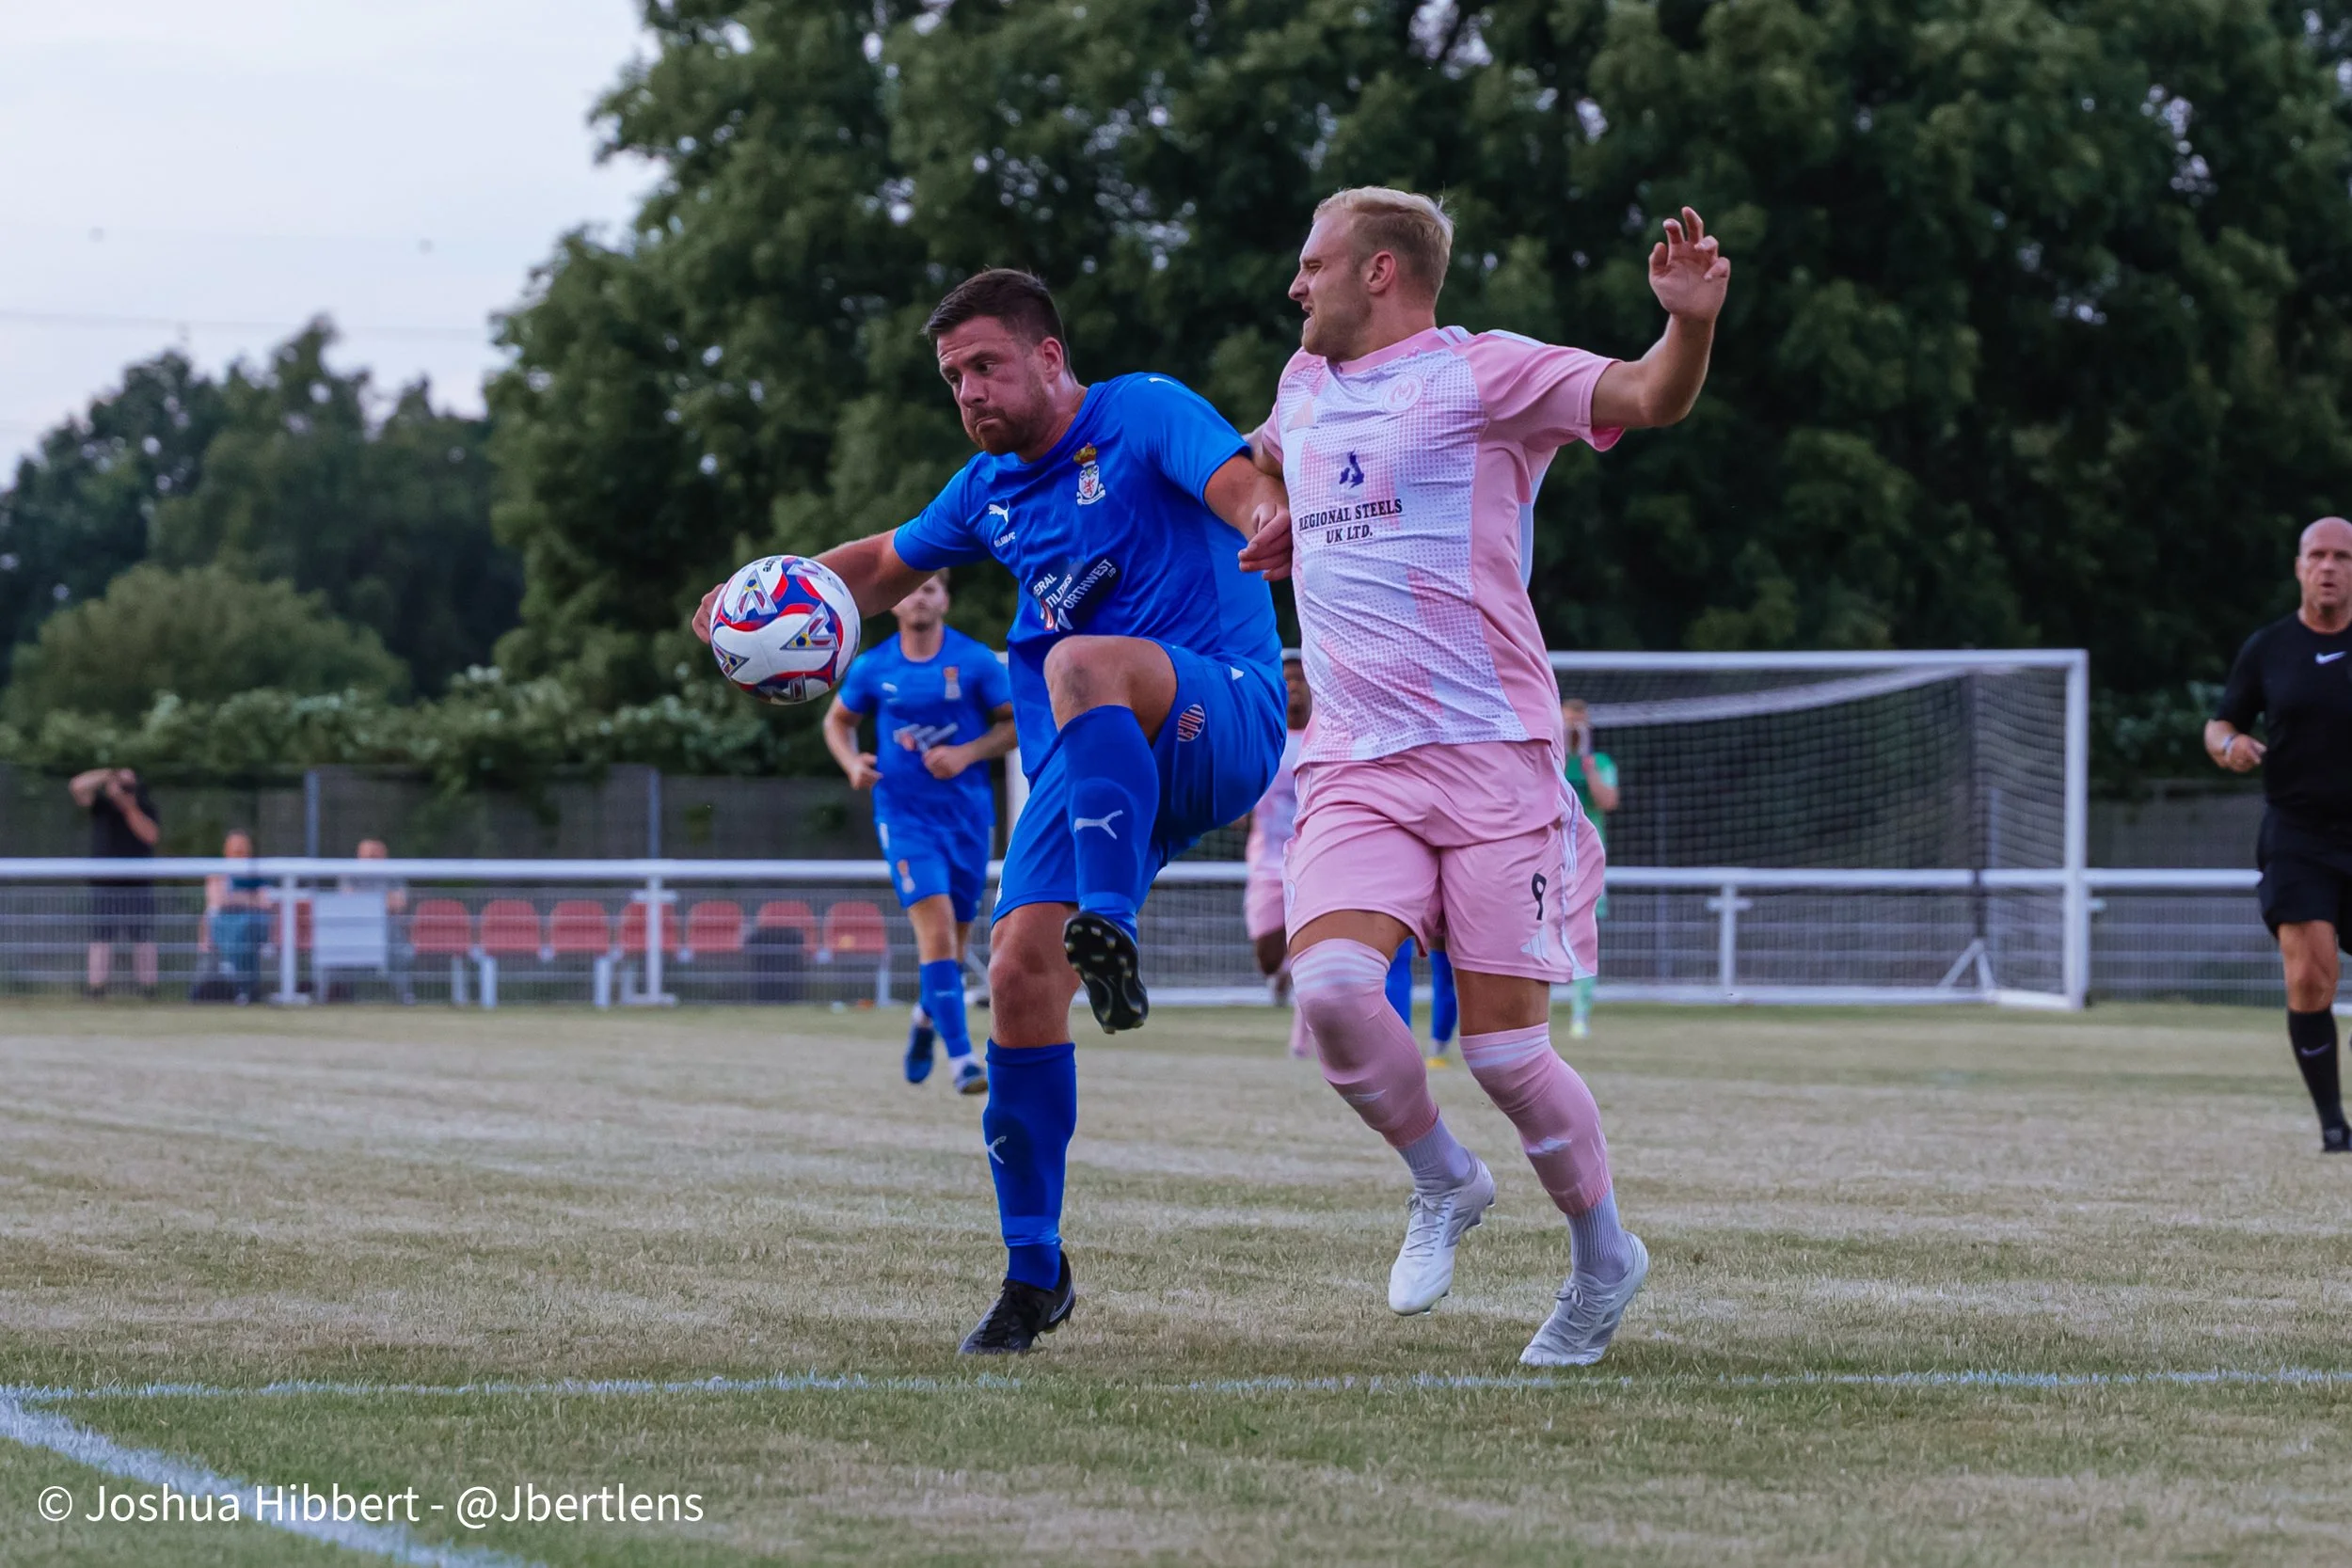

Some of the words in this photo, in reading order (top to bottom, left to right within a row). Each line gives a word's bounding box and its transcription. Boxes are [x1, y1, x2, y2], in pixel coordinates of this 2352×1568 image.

[1299, 507, 1351, 531] REGIONAL
[1355, 499, 1403, 519] STEELS
[1327, 529, 1343, 544] UK
[1346, 524, 1373, 541] LTD.
[1033, 573, 1057, 596] ERAL
[1532, 872, 1548, 921] 9
